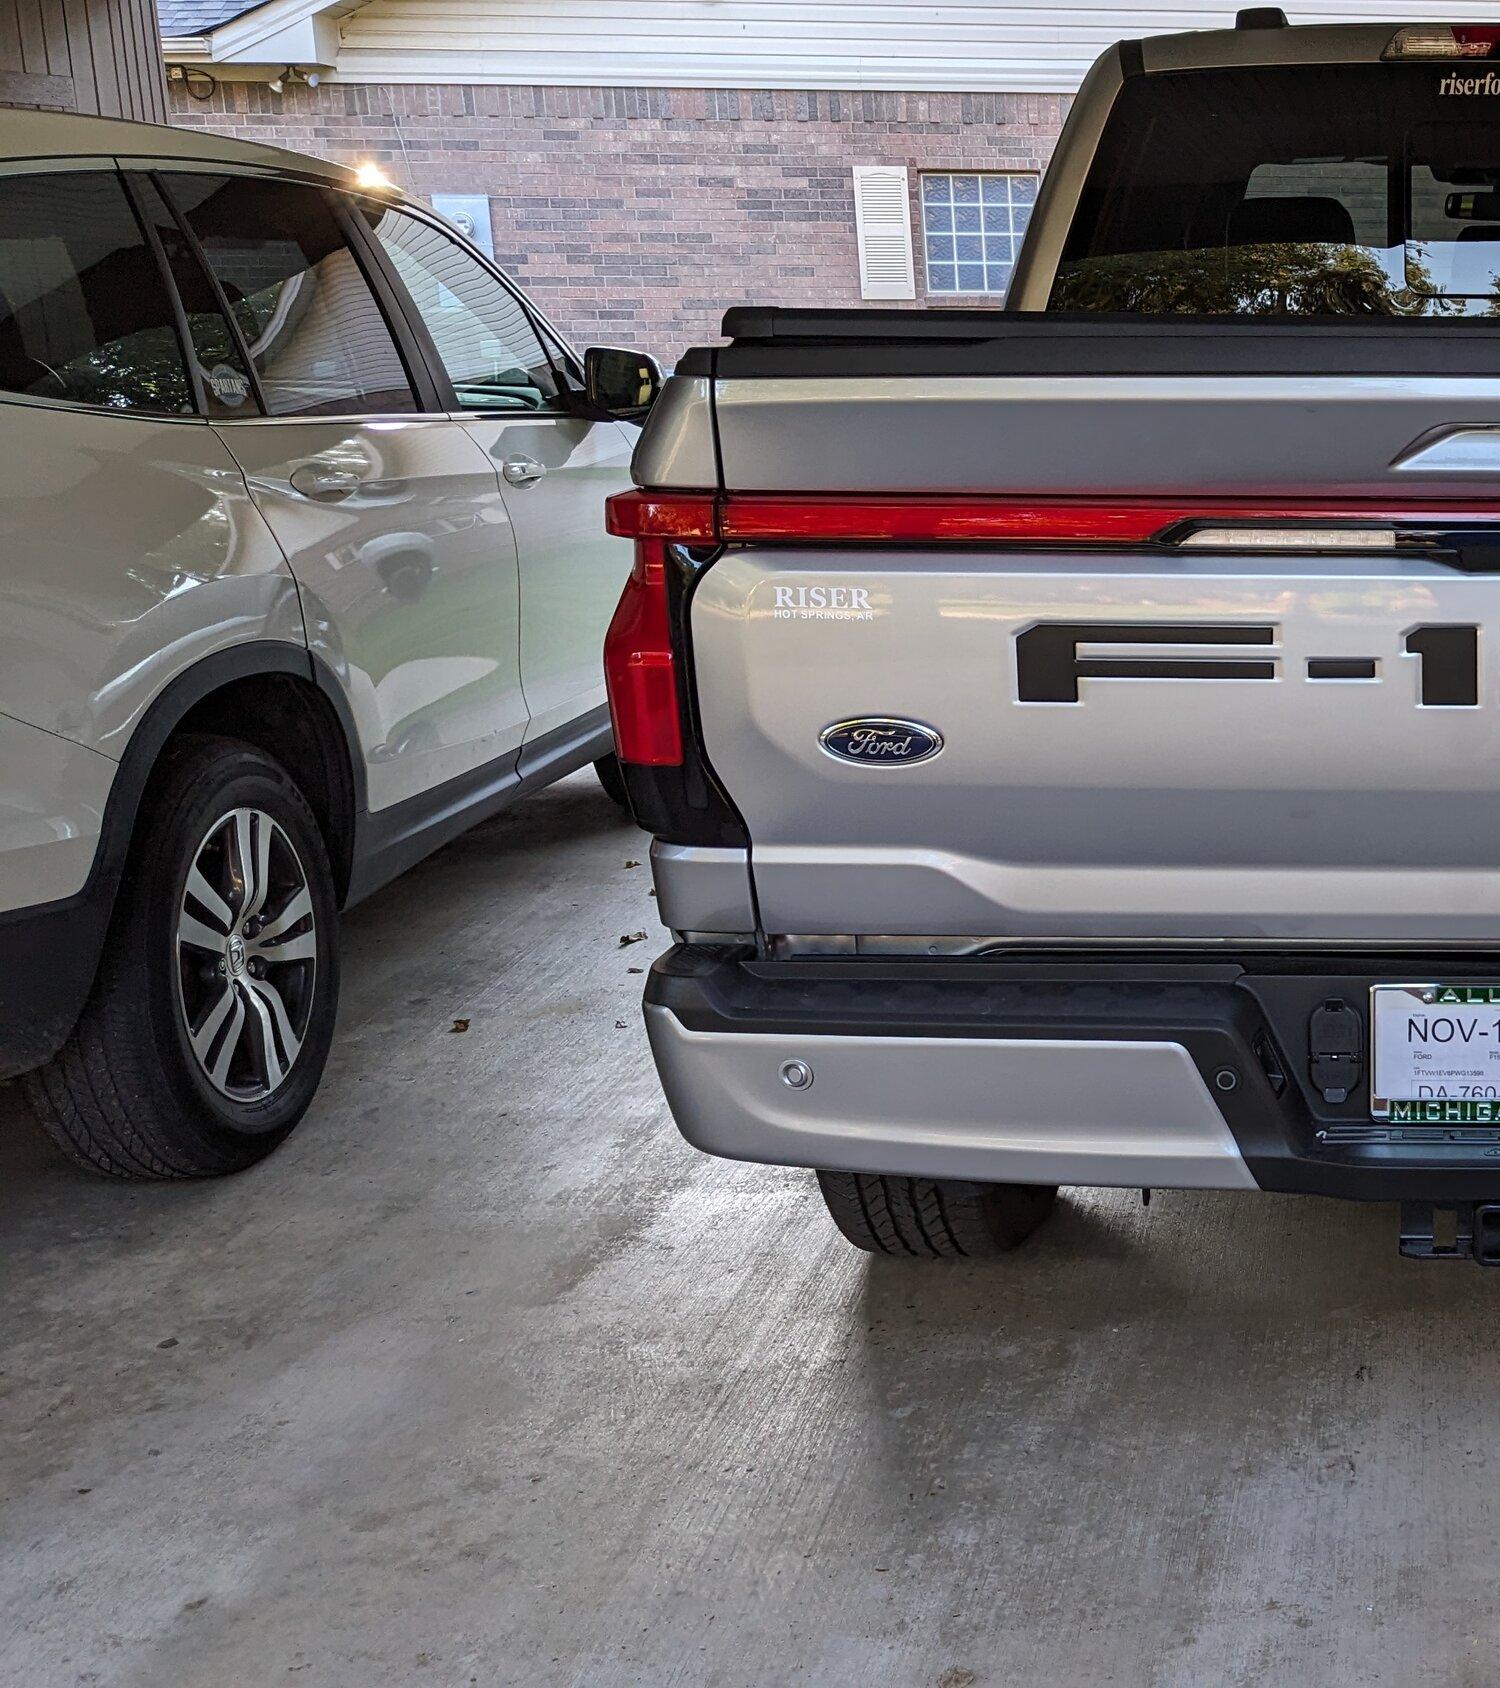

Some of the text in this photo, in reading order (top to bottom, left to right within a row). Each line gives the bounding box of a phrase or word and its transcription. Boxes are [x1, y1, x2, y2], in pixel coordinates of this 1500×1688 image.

[773, 586, 873, 609] RISER
[774, 609, 873, 621] HOT SPRINGS, AR
[848, 728, 913, 756] Ford
